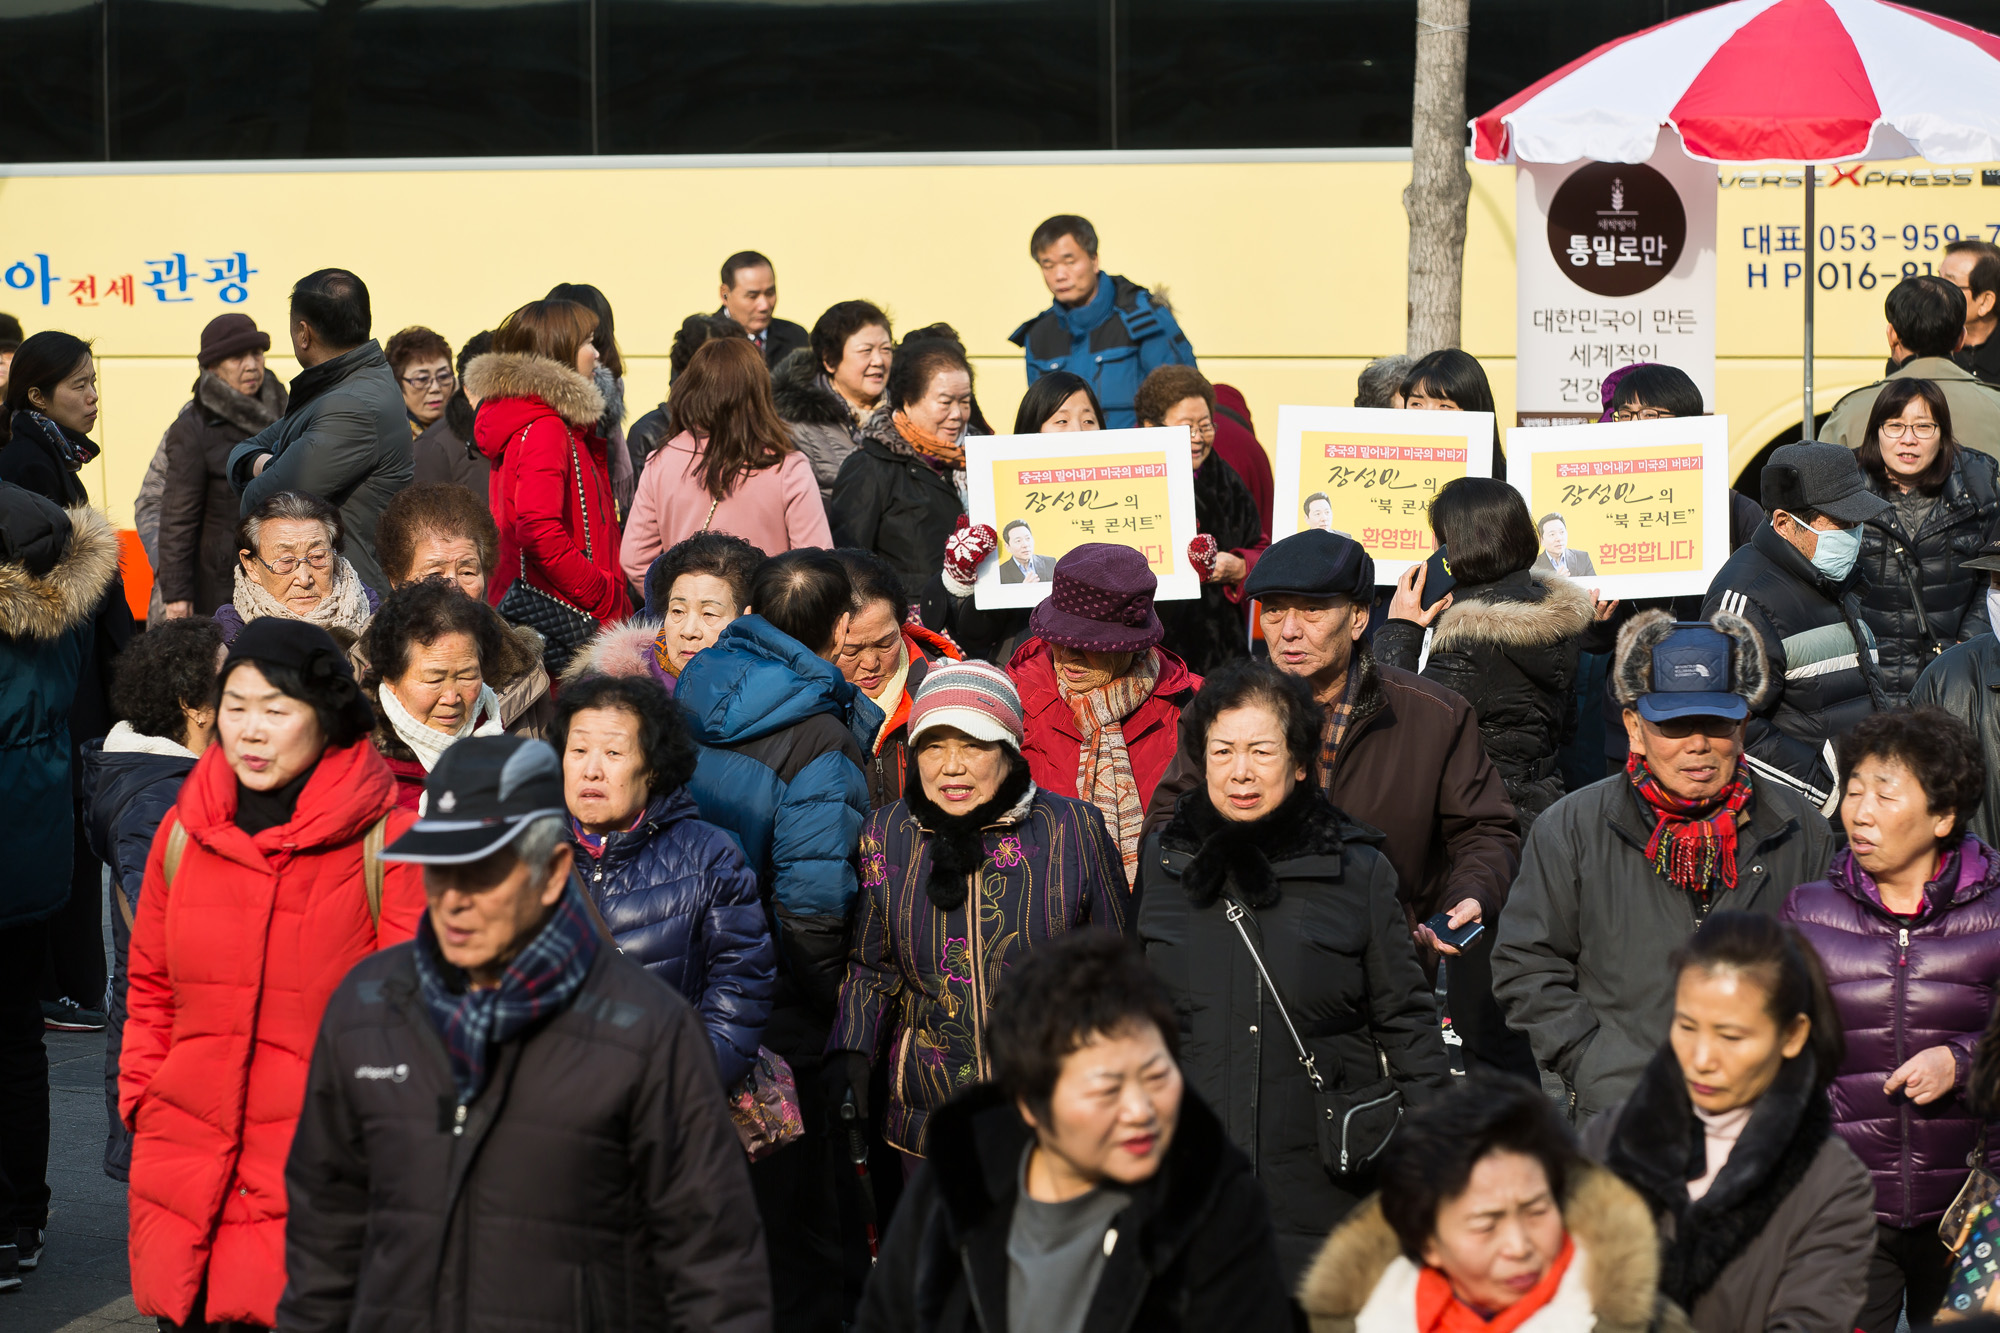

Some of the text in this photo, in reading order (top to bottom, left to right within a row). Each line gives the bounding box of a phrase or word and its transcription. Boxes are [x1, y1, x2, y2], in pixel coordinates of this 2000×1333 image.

[1566, 234, 1668, 267] 통밀로만
[1743, 224, 1805, 254] 대표
[0, 252, 258, 307] 아 전세 관광
[1533, 309, 1697, 334] 대한민국이 만든
[1569, 343, 1658, 368] 세계적인
[1326, 445, 1467, 462] 중국의 밀어내기 미국의 버티기
[1020, 463, 1167, 484] 중국의 밀어내기 미국의 버티기
[1327, 465, 1437, 493] 장성민 의
[1558, 456, 1702, 477] 중국의 밀어내기 미국의 버티기
[1025, 489, 1139, 513] 장성민 의
[1561, 482, 1674, 507] 장성민 의
[1361, 527, 1436, 551] 환영합니
[1599, 539, 1695, 565] 환영합니다
